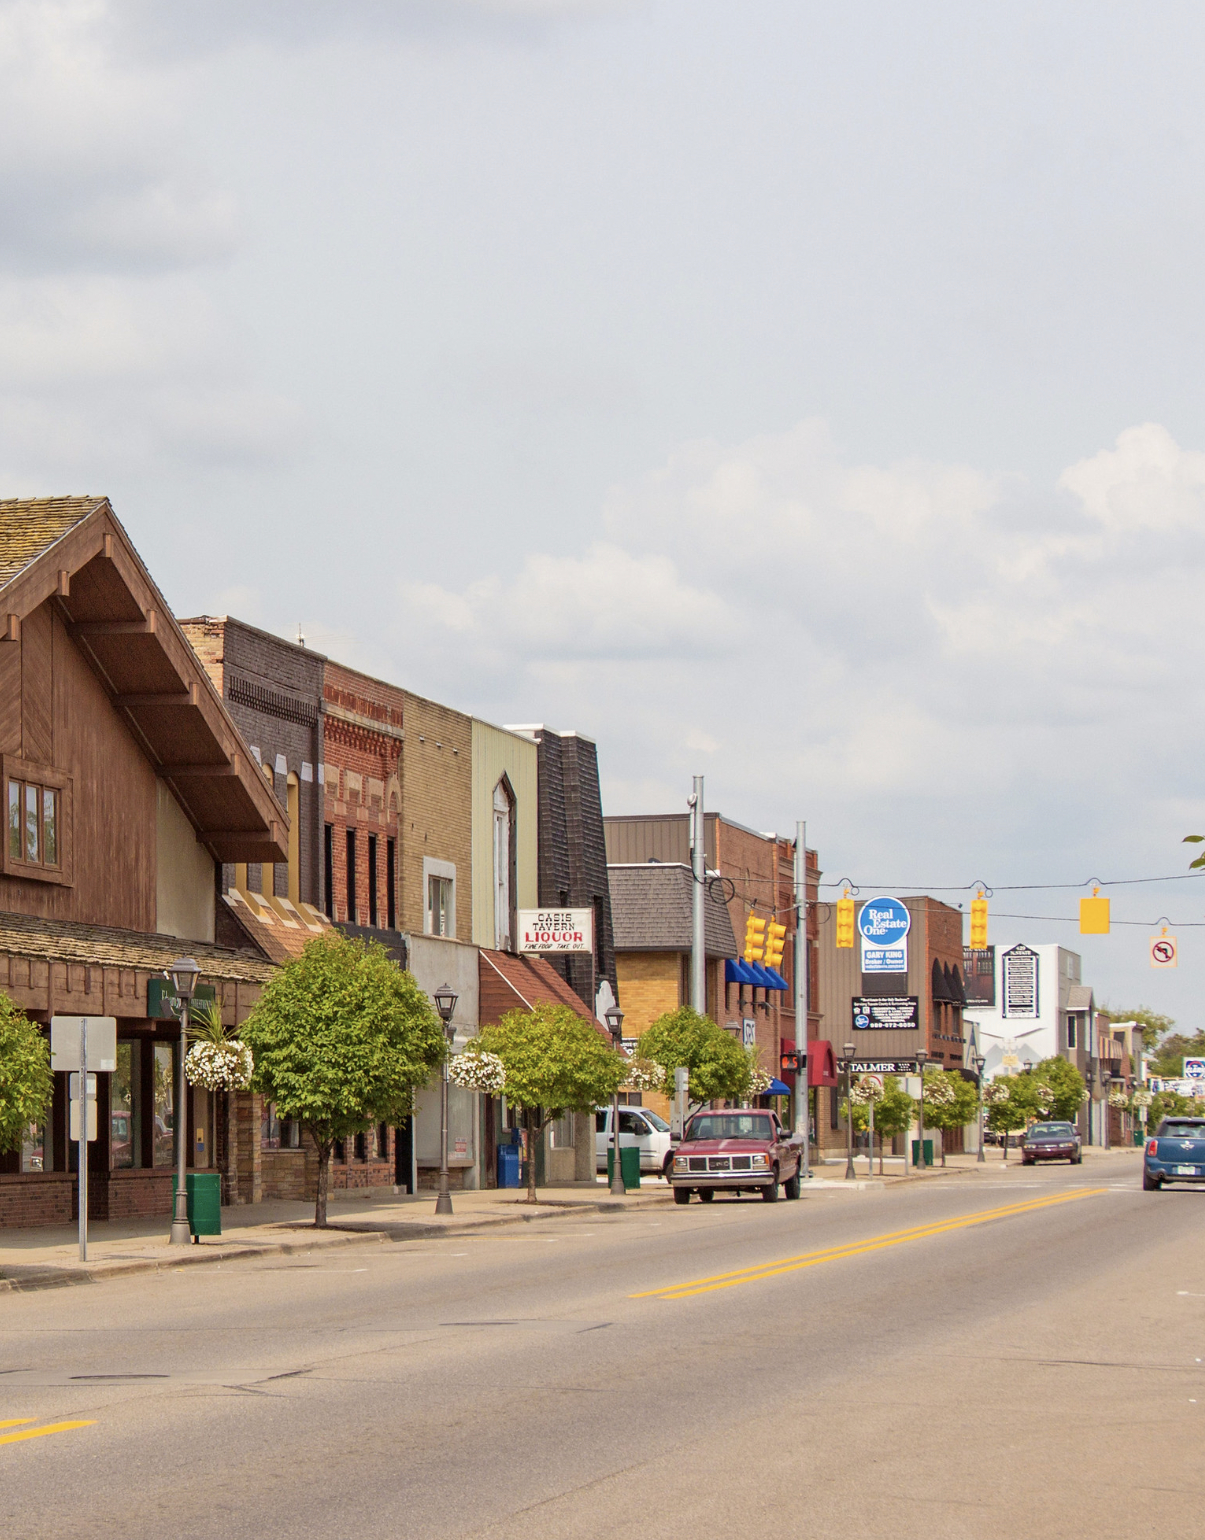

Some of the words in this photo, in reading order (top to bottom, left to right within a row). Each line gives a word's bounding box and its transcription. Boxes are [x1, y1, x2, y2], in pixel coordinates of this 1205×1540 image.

[868, 908, 894, 920] Real
[872, 918, 908, 929] Estate
[863, 925, 887, 935] One
[526, 932, 582, 943] LIQUOR
[866, 951, 885, 959] GARY
[885, 951, 902, 959] KING
[851, 1064, 896, 1072] TALMER
